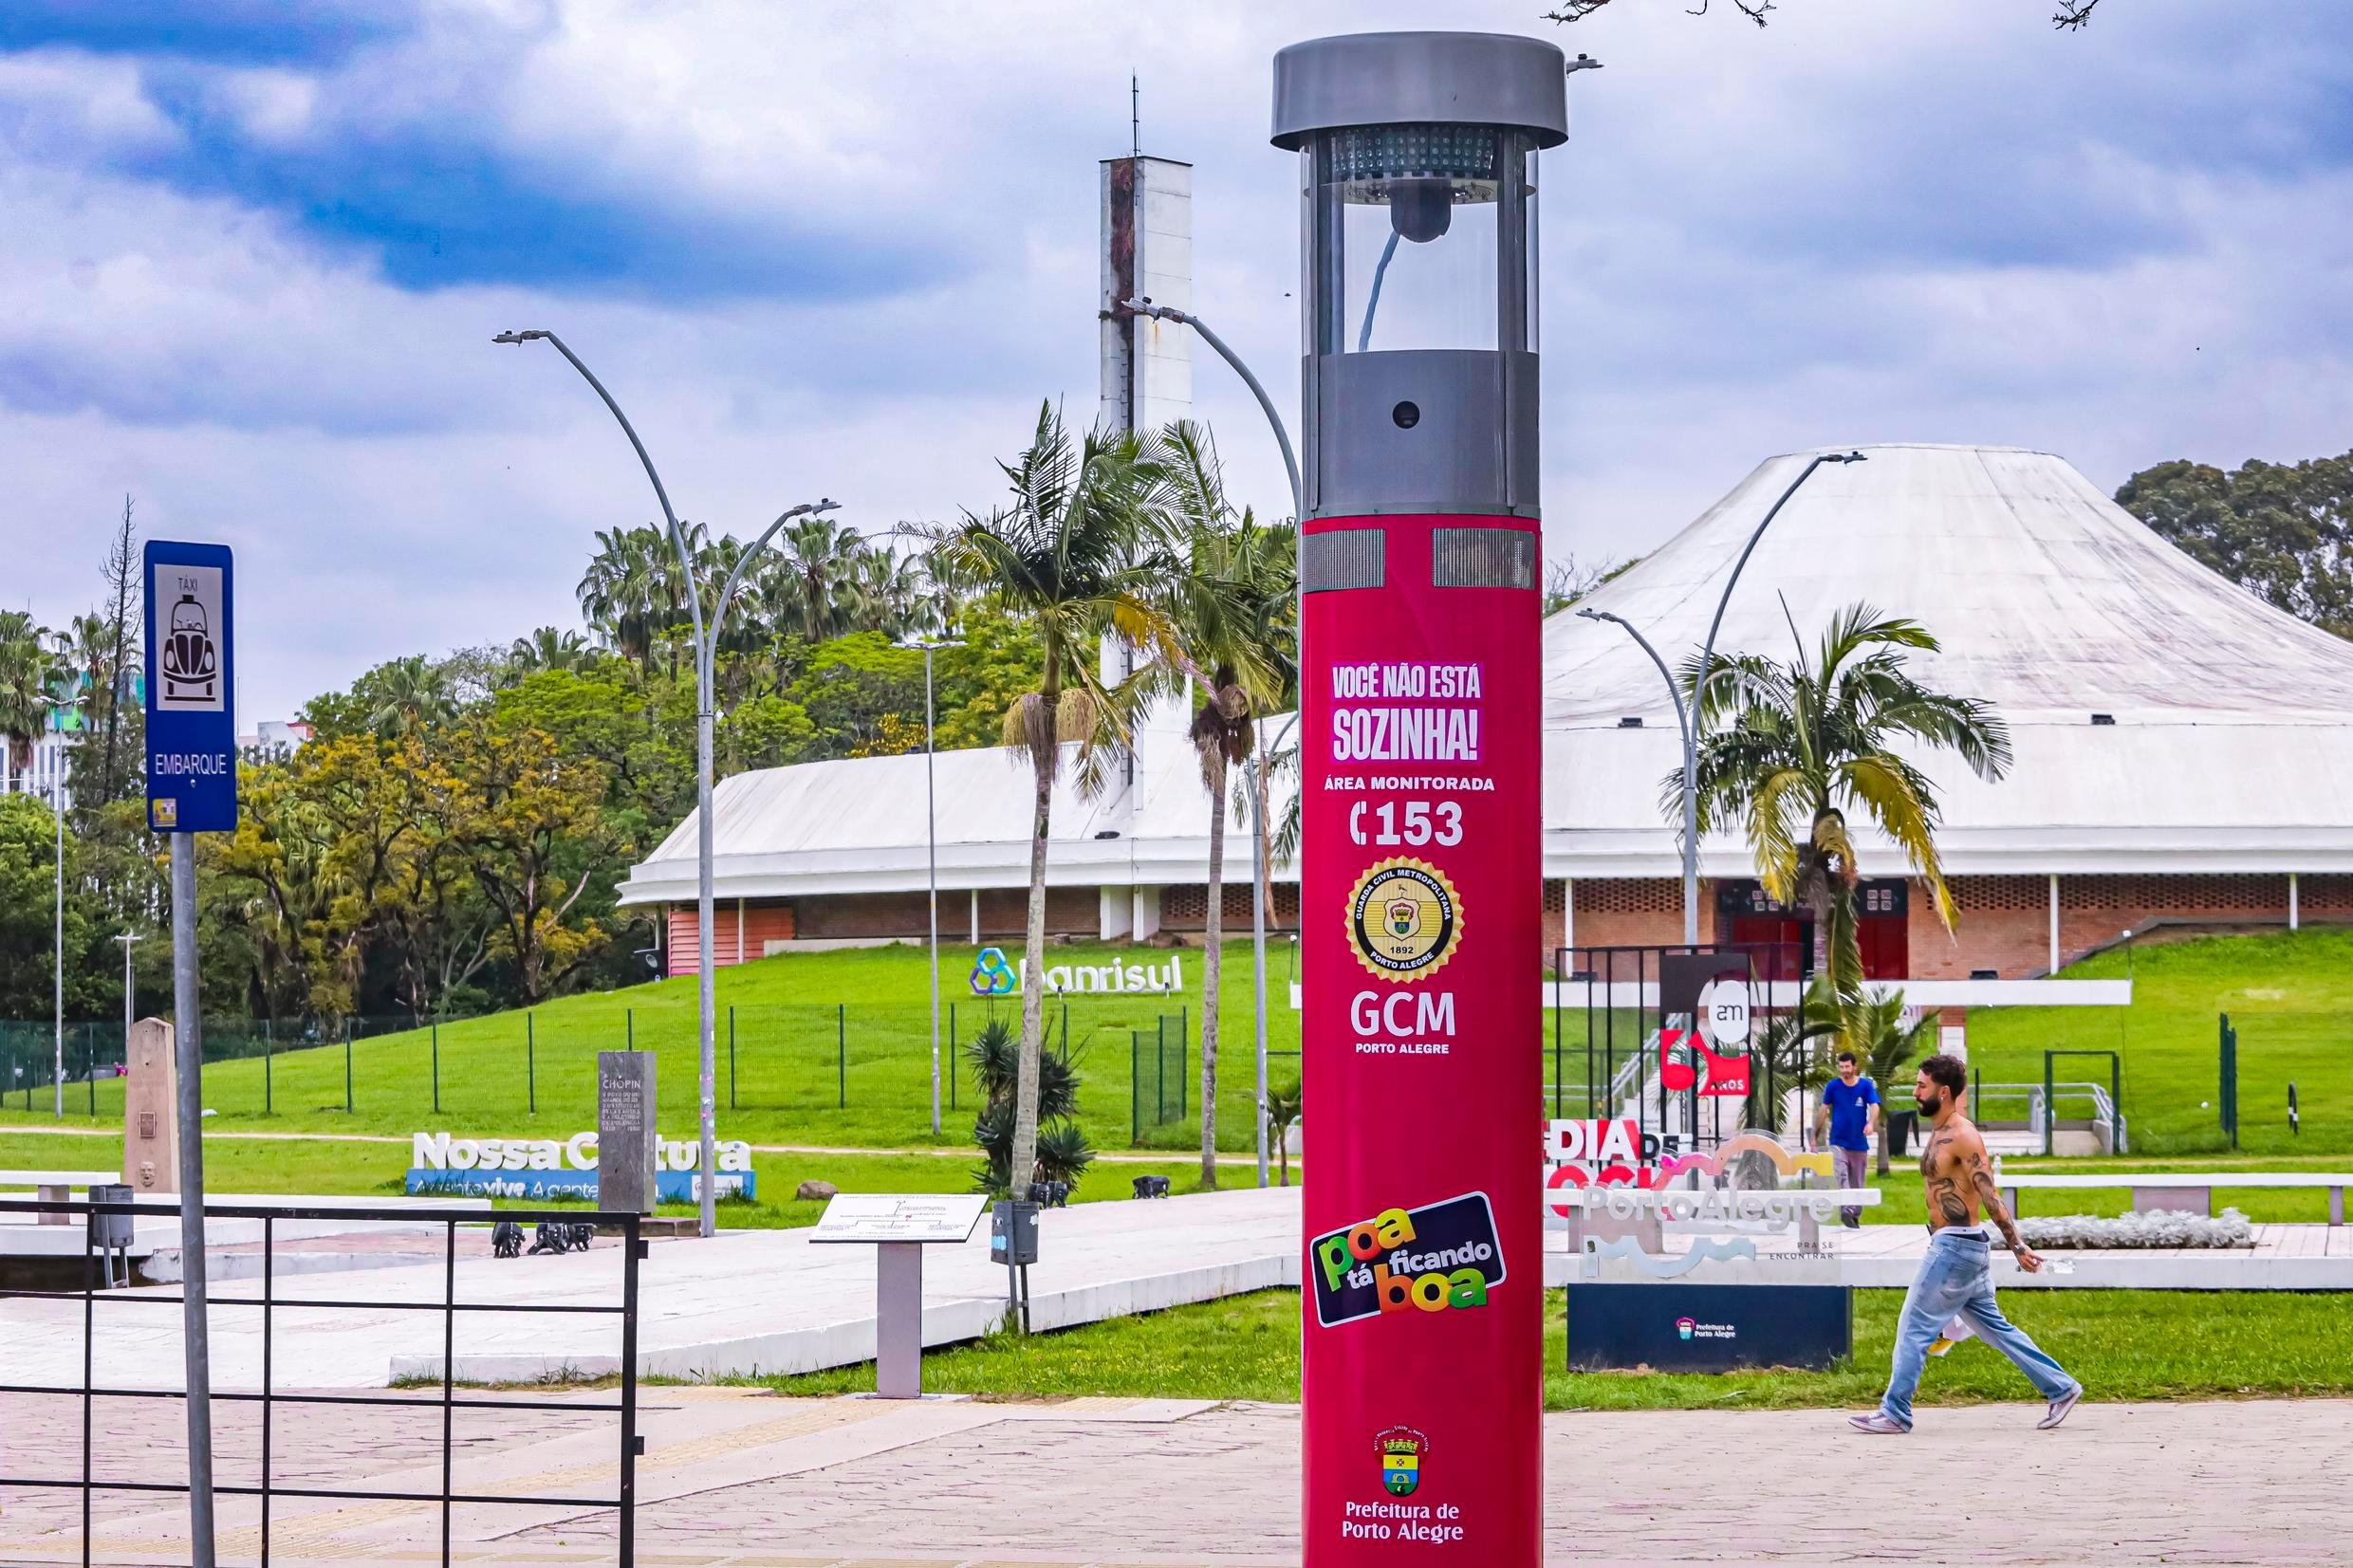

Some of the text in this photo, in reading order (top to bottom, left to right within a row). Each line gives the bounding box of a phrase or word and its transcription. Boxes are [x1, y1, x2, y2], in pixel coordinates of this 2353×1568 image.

[1332, 662, 1480, 698] VOCÊ NÃO ESTÁ
[1333, 708, 1478, 761] SOZINHA!
[155, 753, 227, 775] EMBARQUE
[1325, 774, 1495, 790] ÁREA MONITORADA
[1376, 801, 1464, 846] 153
[1356, 869, 1452, 920] GUARDA CIVIL METROPOLITANA
[1370, 950, 1434, 968] PORTO ALEGRE
[1390, 946, 1414, 954] 1892
[1350, 990, 1455, 1037] GCM
[1356, 1042, 1450, 1054] PORTO ALEGRE
[602, 1079, 641, 1089] CHOPIN
[413, 1132, 562, 1171] Nossa
[1549, 1118, 1637, 1160] DIA
[483, 1176, 527, 1197] vive
[1318, 1208, 1417, 1293] poa
[1346, 1241, 1492, 1289] tá ficando
[1769, 1252, 1834, 1261] ENCONTRAR
[1374, 1264, 1488, 1314] boa
[1345, 1501, 1459, 1519] Prefeitura de
[1343, 1520, 1464, 1544] Porto Alegre
